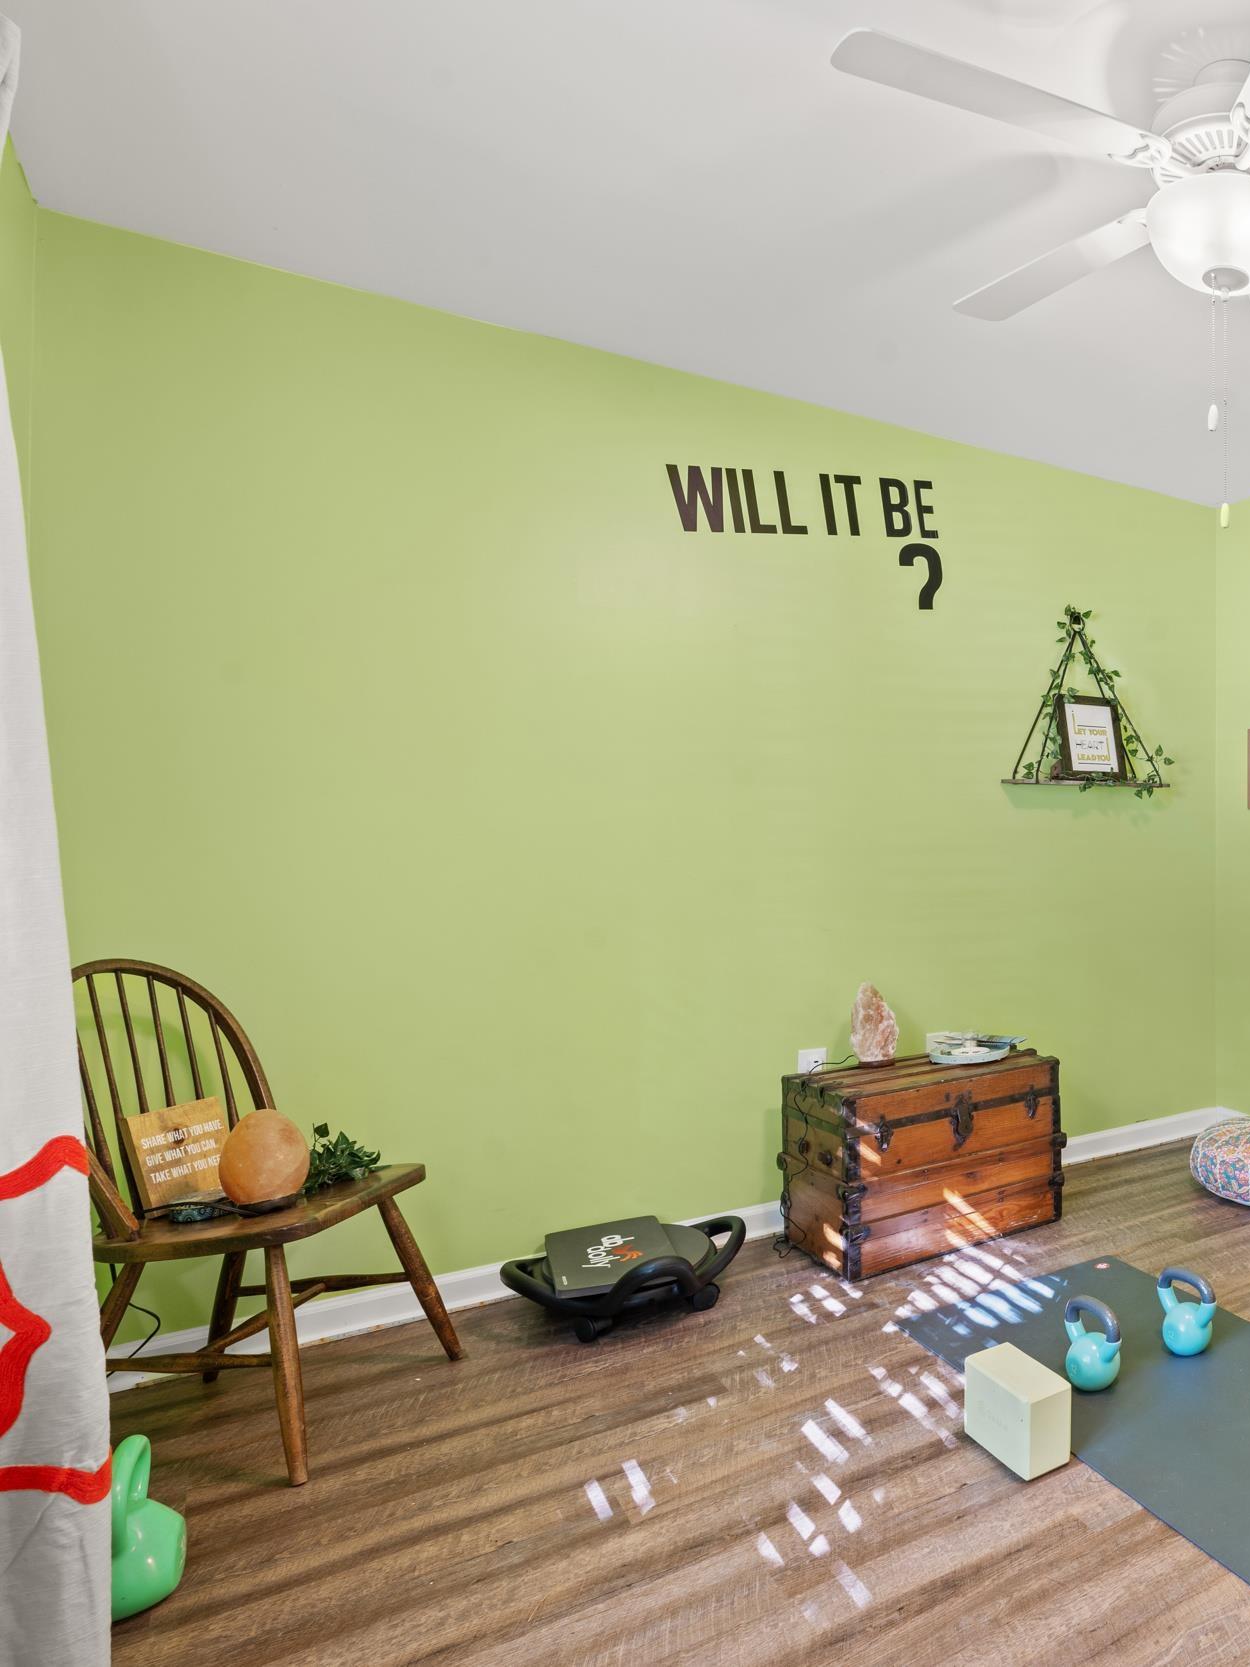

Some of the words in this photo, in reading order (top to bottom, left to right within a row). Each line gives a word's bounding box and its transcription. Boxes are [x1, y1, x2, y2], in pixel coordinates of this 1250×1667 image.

[665, 463, 809, 535] WILL
[818, 473, 862, 537] IT
[879, 477, 939, 539] BE
[898, 543, 943, 610] ?
[1088, 729, 1107, 737] YOUR
[141, 1134, 167, 1149] SHARE
[167, 1128, 188, 1142] WHAT
[189, 1125, 202, 1136] YOU
[203, 1120, 224, 1133] HAVE.
[146, 1154, 165, 1167] GIVE
[164, 1147, 186, 1161] WHAT
[186, 1143, 201, 1155] YOU
[150, 1171, 171, 1184] TAKE
[171, 1163, 193, 1178] WHAT
[193, 1159, 207, 1170] YOU
[208, 1154, 221, 1166] NEE
